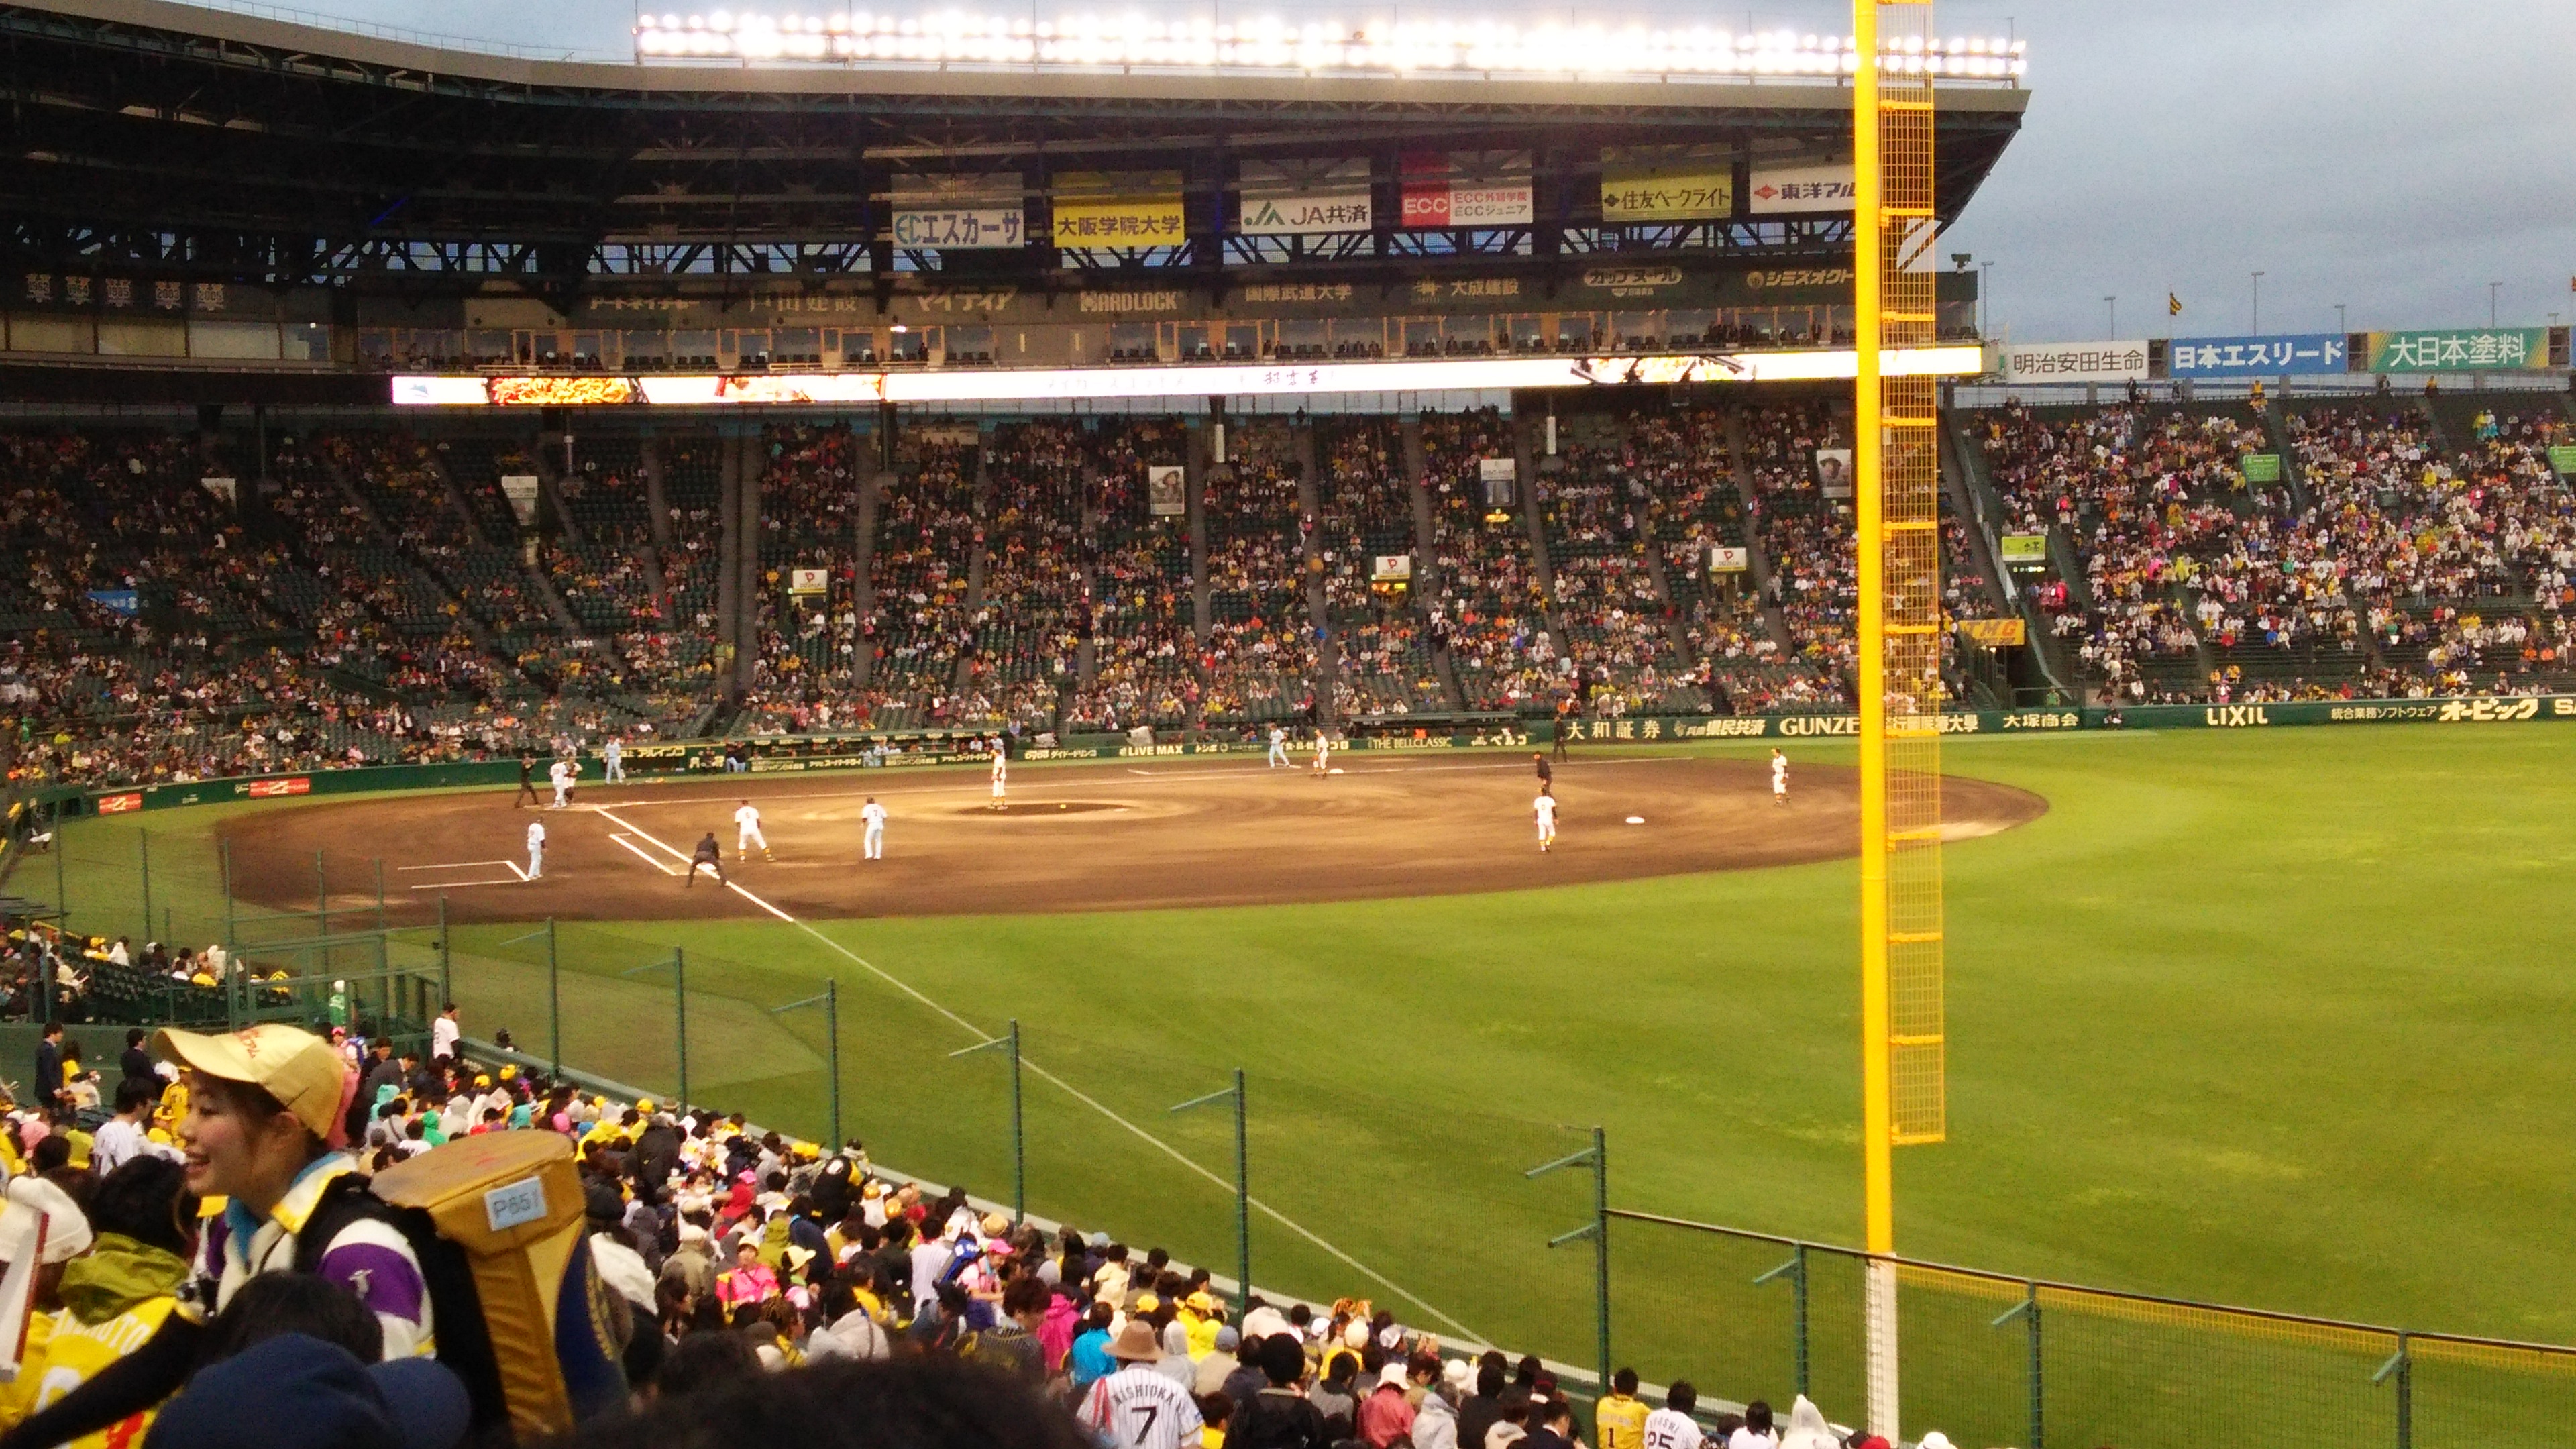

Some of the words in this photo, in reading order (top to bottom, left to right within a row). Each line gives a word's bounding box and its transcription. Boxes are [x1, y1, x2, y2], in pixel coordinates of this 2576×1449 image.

[1403, 197, 1448, 215] ECC
[1621, 189, 1730, 209] 住友ベークライト
[1291, 203, 1368, 225] JA共済
[1454, 205, 1527, 217] ECCジュニア
[922, 212, 1020, 245] エスカーサ
[1058, 215, 1181, 236] 大阪学院大学
[2174, 341, 2343, 369] 日本エスリード
[2390, 333, 2526, 367] 大日本塗料
[2014, 349, 2144, 374] 明治安田生命
[2207, 706, 2268, 726] LIXIL
[2331, 706, 2437, 720] 統合業務ソフトウェア
[2438, 698, 2538, 722] オービック
[1566, 719, 1661, 740] 大和証券
[1779, 716, 1860, 736] GUNZE
[2004, 712, 2079, 729] 大塚商会
[1157, 745, 1183, 755] MAX
[1372, 739, 1391, 749] THE
[1491, 735, 1527, 746] ベルコ
[1113, 1384, 1176, 1406] NISHIOKA
[1132, 1406, 1158, 1445] 7
[1608, 1428, 1615, 1448] 1
[1648, 1431, 1675, 1449] 25
